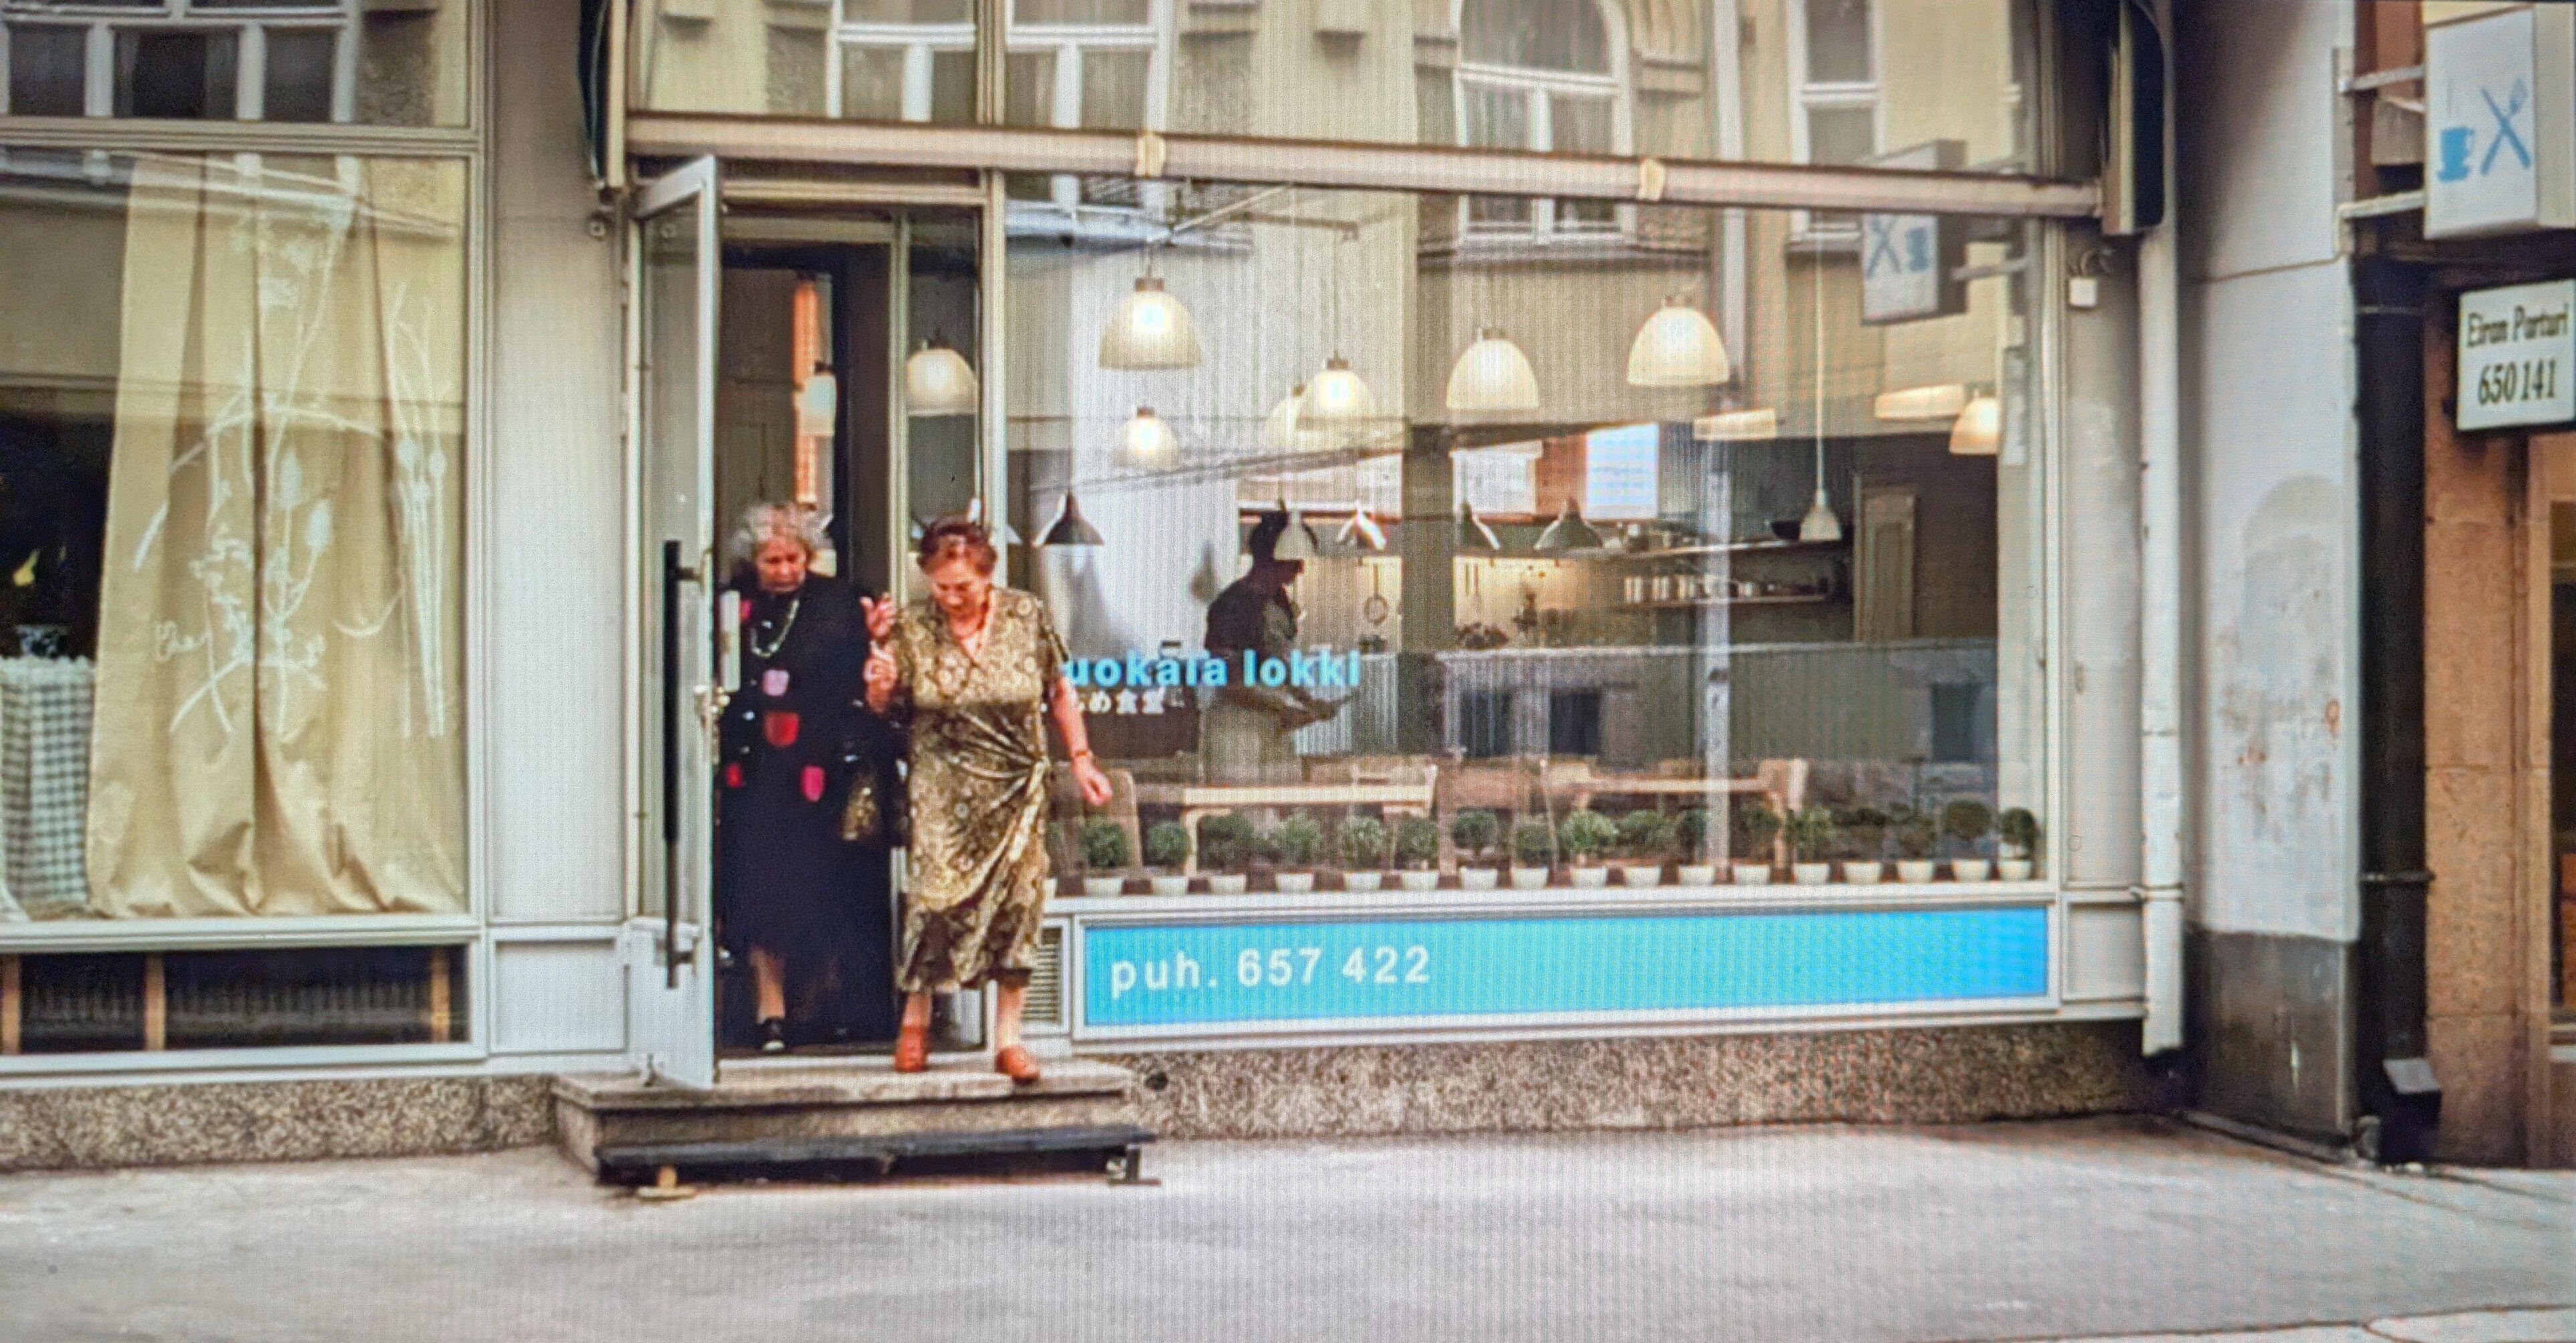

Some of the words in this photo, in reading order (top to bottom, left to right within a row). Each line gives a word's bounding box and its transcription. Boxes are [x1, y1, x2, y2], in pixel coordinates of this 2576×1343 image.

[1063, 649, 1228, 687] uokala
[1243, 648, 1360, 687] lokki
[1110, 950, 1216, 999] puh.
[1237, 946, 1323, 987] 657
[1342, 945, 1430, 985] 422
